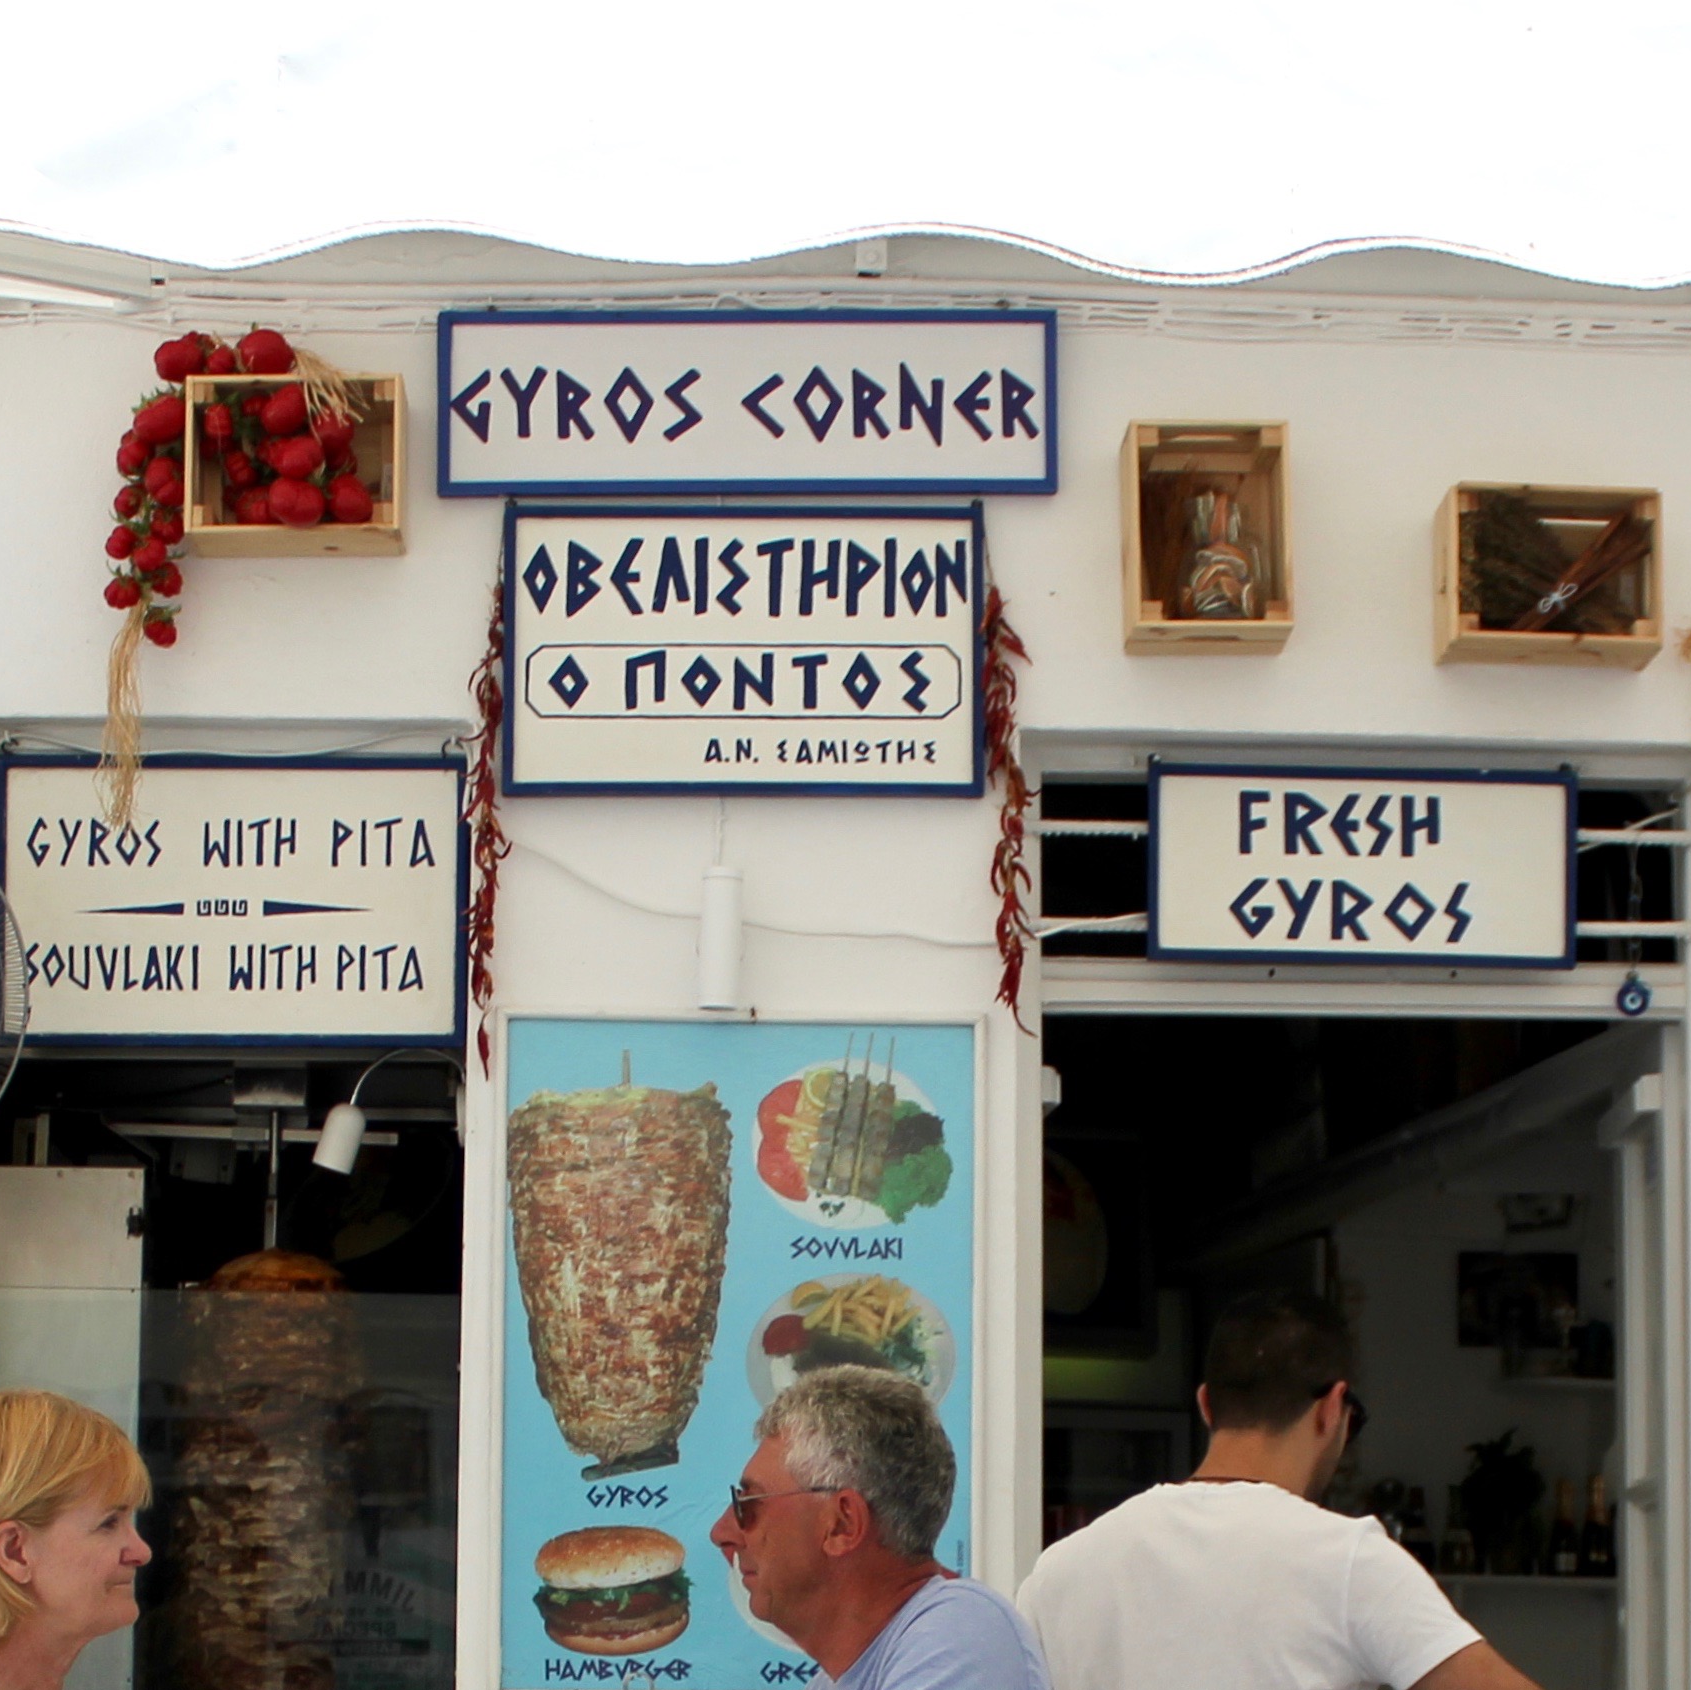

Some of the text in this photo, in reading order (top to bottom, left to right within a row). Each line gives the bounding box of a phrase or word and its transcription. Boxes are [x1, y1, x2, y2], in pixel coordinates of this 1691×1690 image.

[450, 362, 1039, 446] GYROS CORNER
[522, 536, 968, 617] ΟΒΕΛΙΣΤΗΡΙΟΝ
[548, 650, 933, 712] Ο ΠΟΝΤΟΣ
[704, 738, 936, 764] Α.Ν. ΣΑΜΙΩΤΗΣ
[26, 817, 436, 868] GYROS WITH PITA
[1238, 790, 1441, 857] FRESH
[1229, 878, 1472, 943] GYROS
[27, 943, 424, 992] SOUVLAKI WITH PITA
[586, 1485, 669, 1509] GYROS
[760, 1660, 821, 1685] GREE
